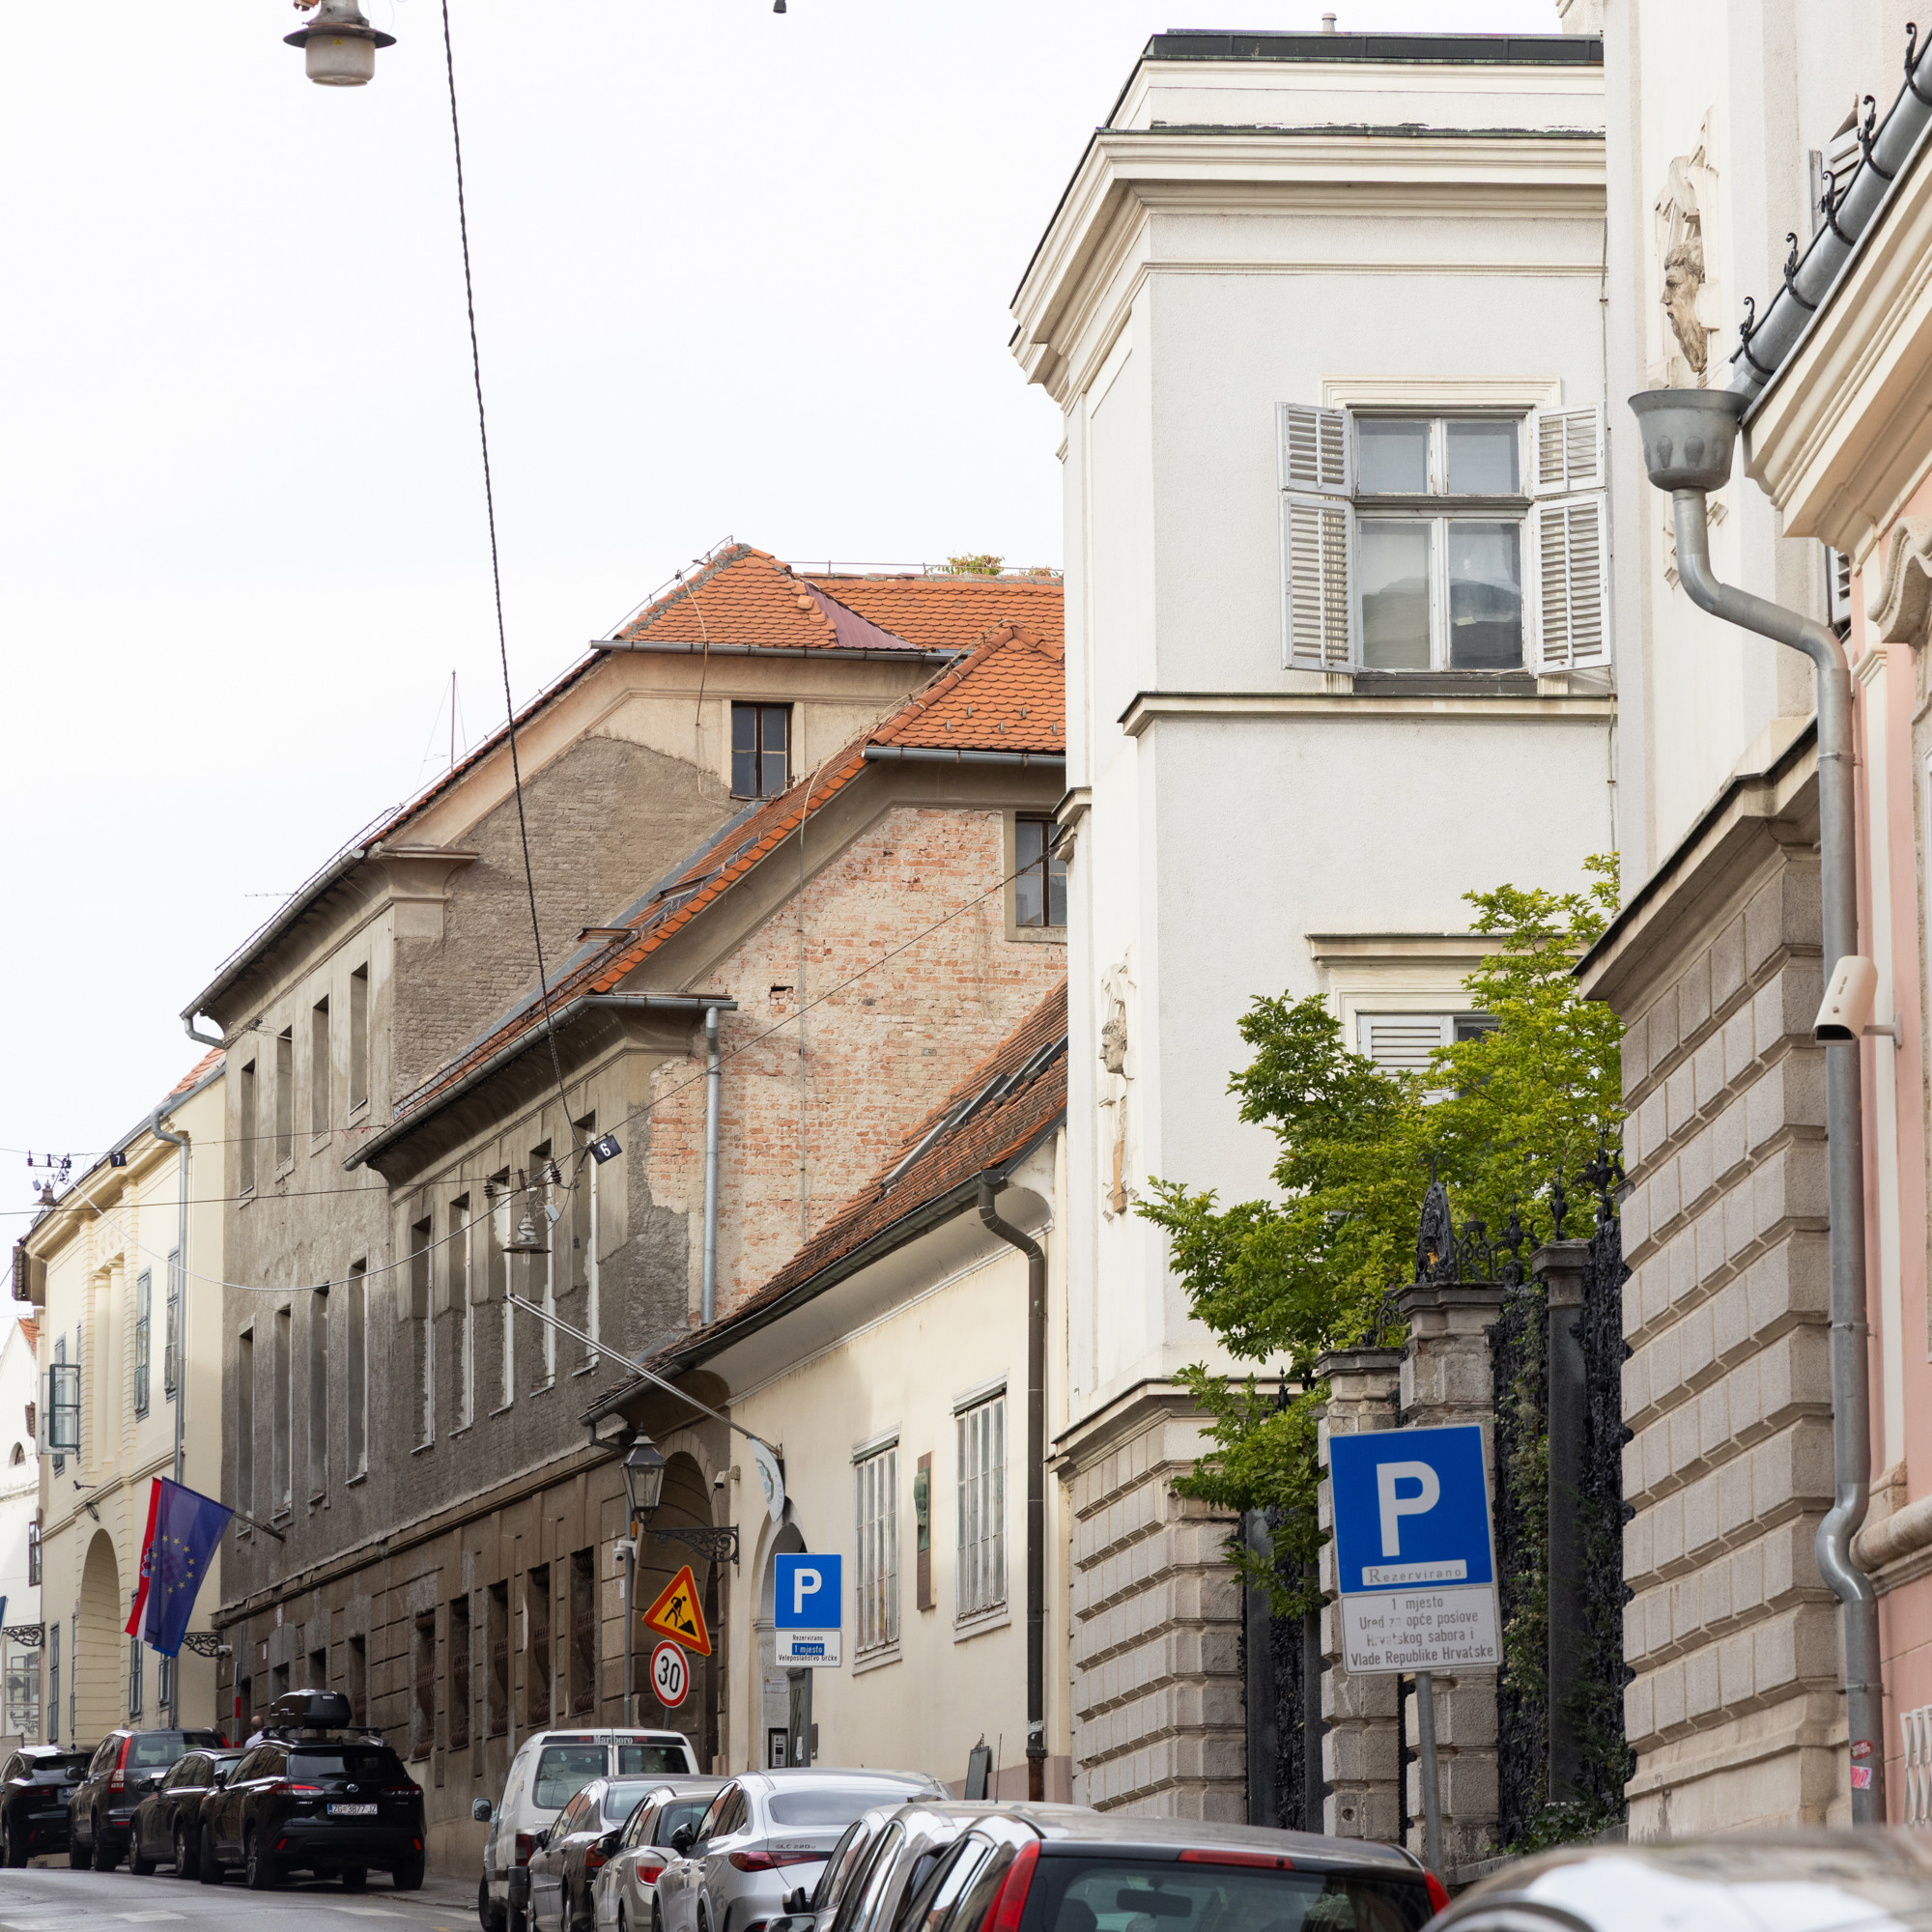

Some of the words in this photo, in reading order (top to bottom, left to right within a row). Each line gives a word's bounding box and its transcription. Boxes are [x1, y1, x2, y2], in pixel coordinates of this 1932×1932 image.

[600, 1143, 611, 1157] 6
[1376, 1461, 1440, 1557] P
[1368, 1567, 1462, 1583] Rezervirano
[793, 1568, 822, 1614] P
[1392, 1598, 1397, 1610] 1
[1406, 1595, 1444, 1612] mjesto
[1359, 1615, 1385, 1630] Ured
[1406, 1612, 1433, 1629] opće
[1428, 1628, 1465, 1643] sabora
[1470, 1627, 1475, 1640] i
[794, 1644, 798, 1653] 1
[800, 1644, 823, 1656] mjesto
[1350, 1651, 1381, 1666] Vlade
[1385, 1649, 1438, 1666] Republike
[1442, 1644, 1493, 1661] Hrvatske
[658, 1655, 681, 1693] 30
[593, 1735, 634, 1745] Marlboro
[333, 1804, 343, 1813] ZG
